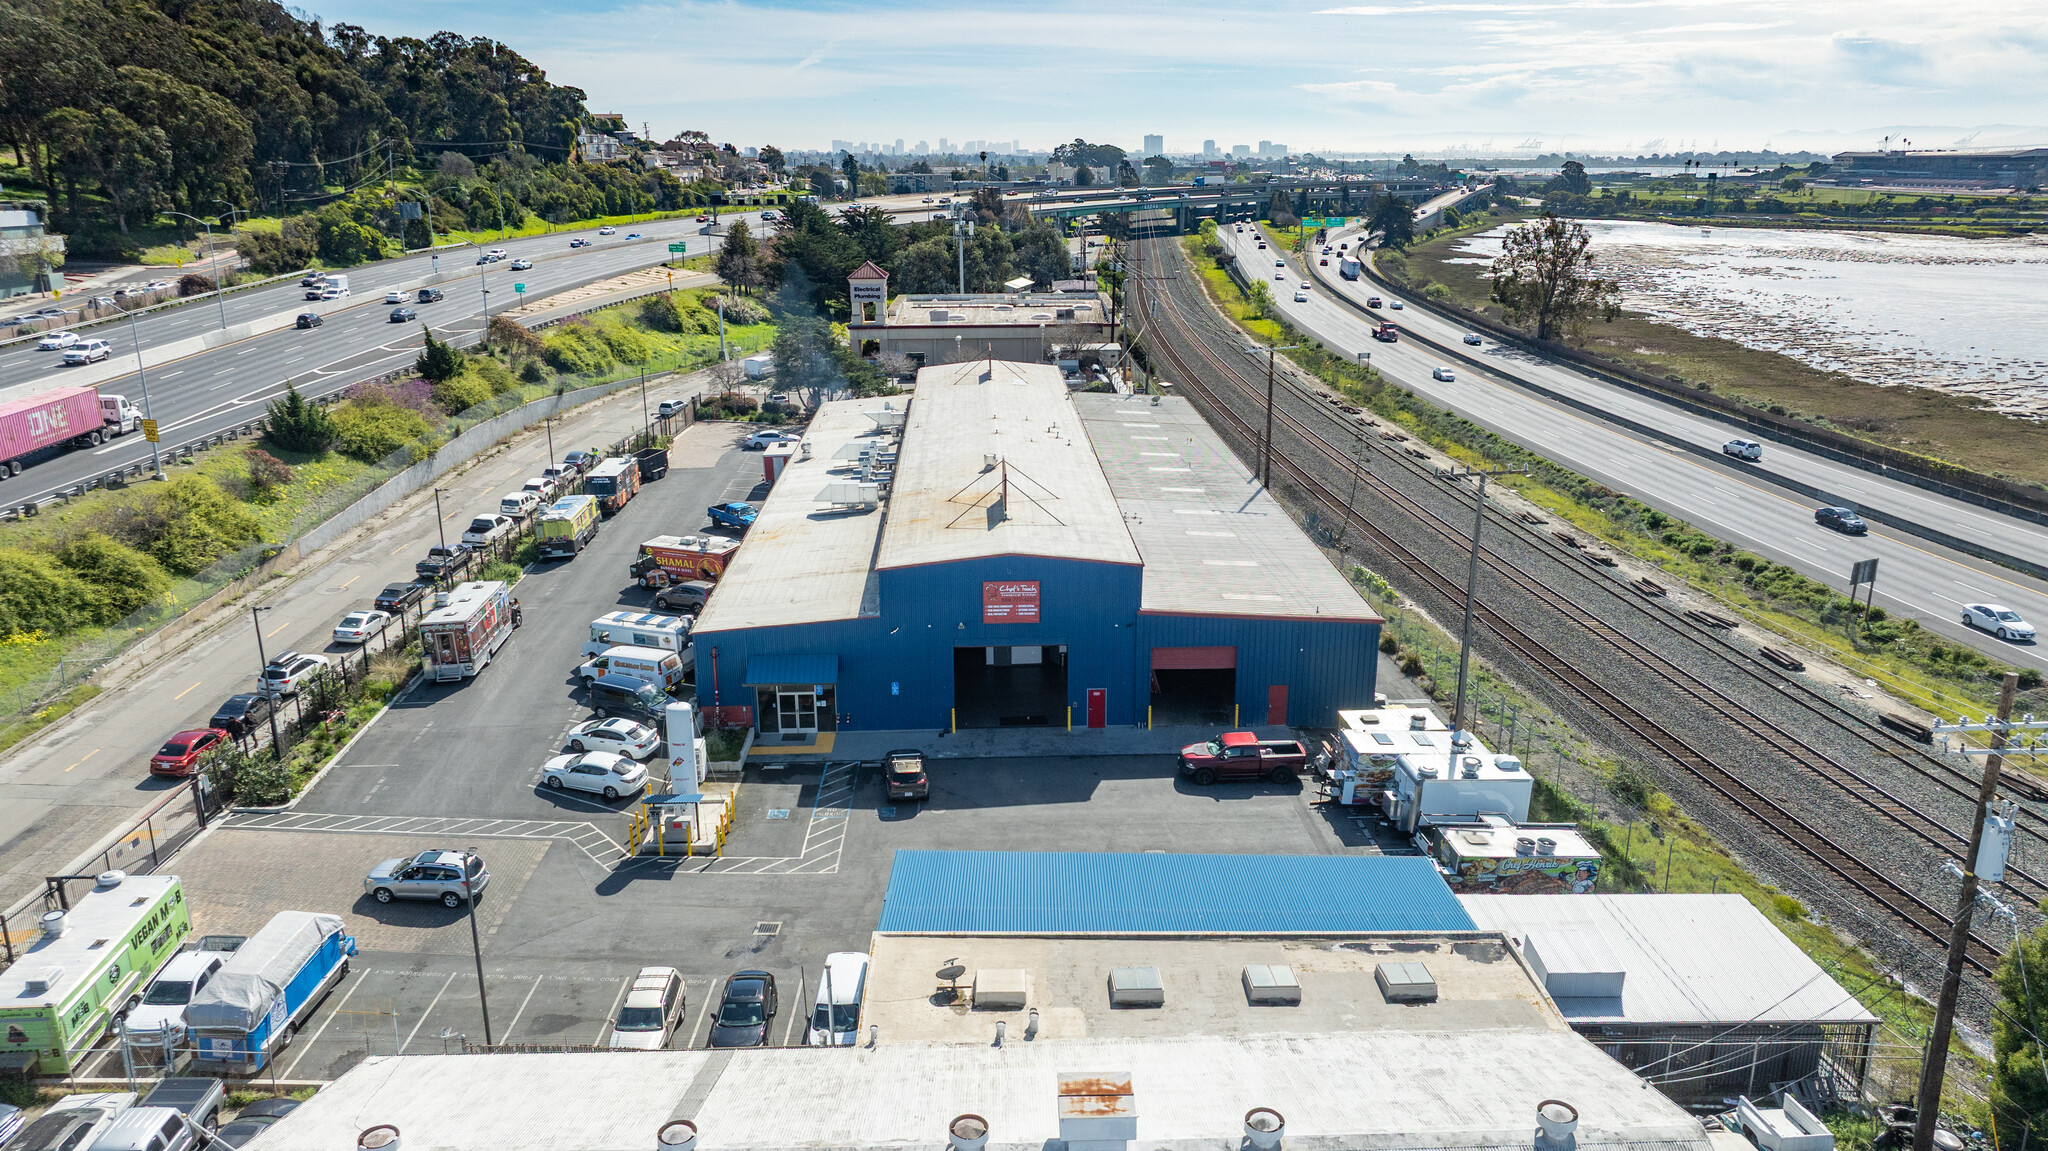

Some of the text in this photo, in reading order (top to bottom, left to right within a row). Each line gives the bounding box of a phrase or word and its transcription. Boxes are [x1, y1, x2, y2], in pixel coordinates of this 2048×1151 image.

[28, 403, 69, 437] ONE
[656, 556, 695, 568] SHAMAL
[1501, 859, 1559, 872] Chef Henrik
[131, 912, 160, 951] VEGAN
